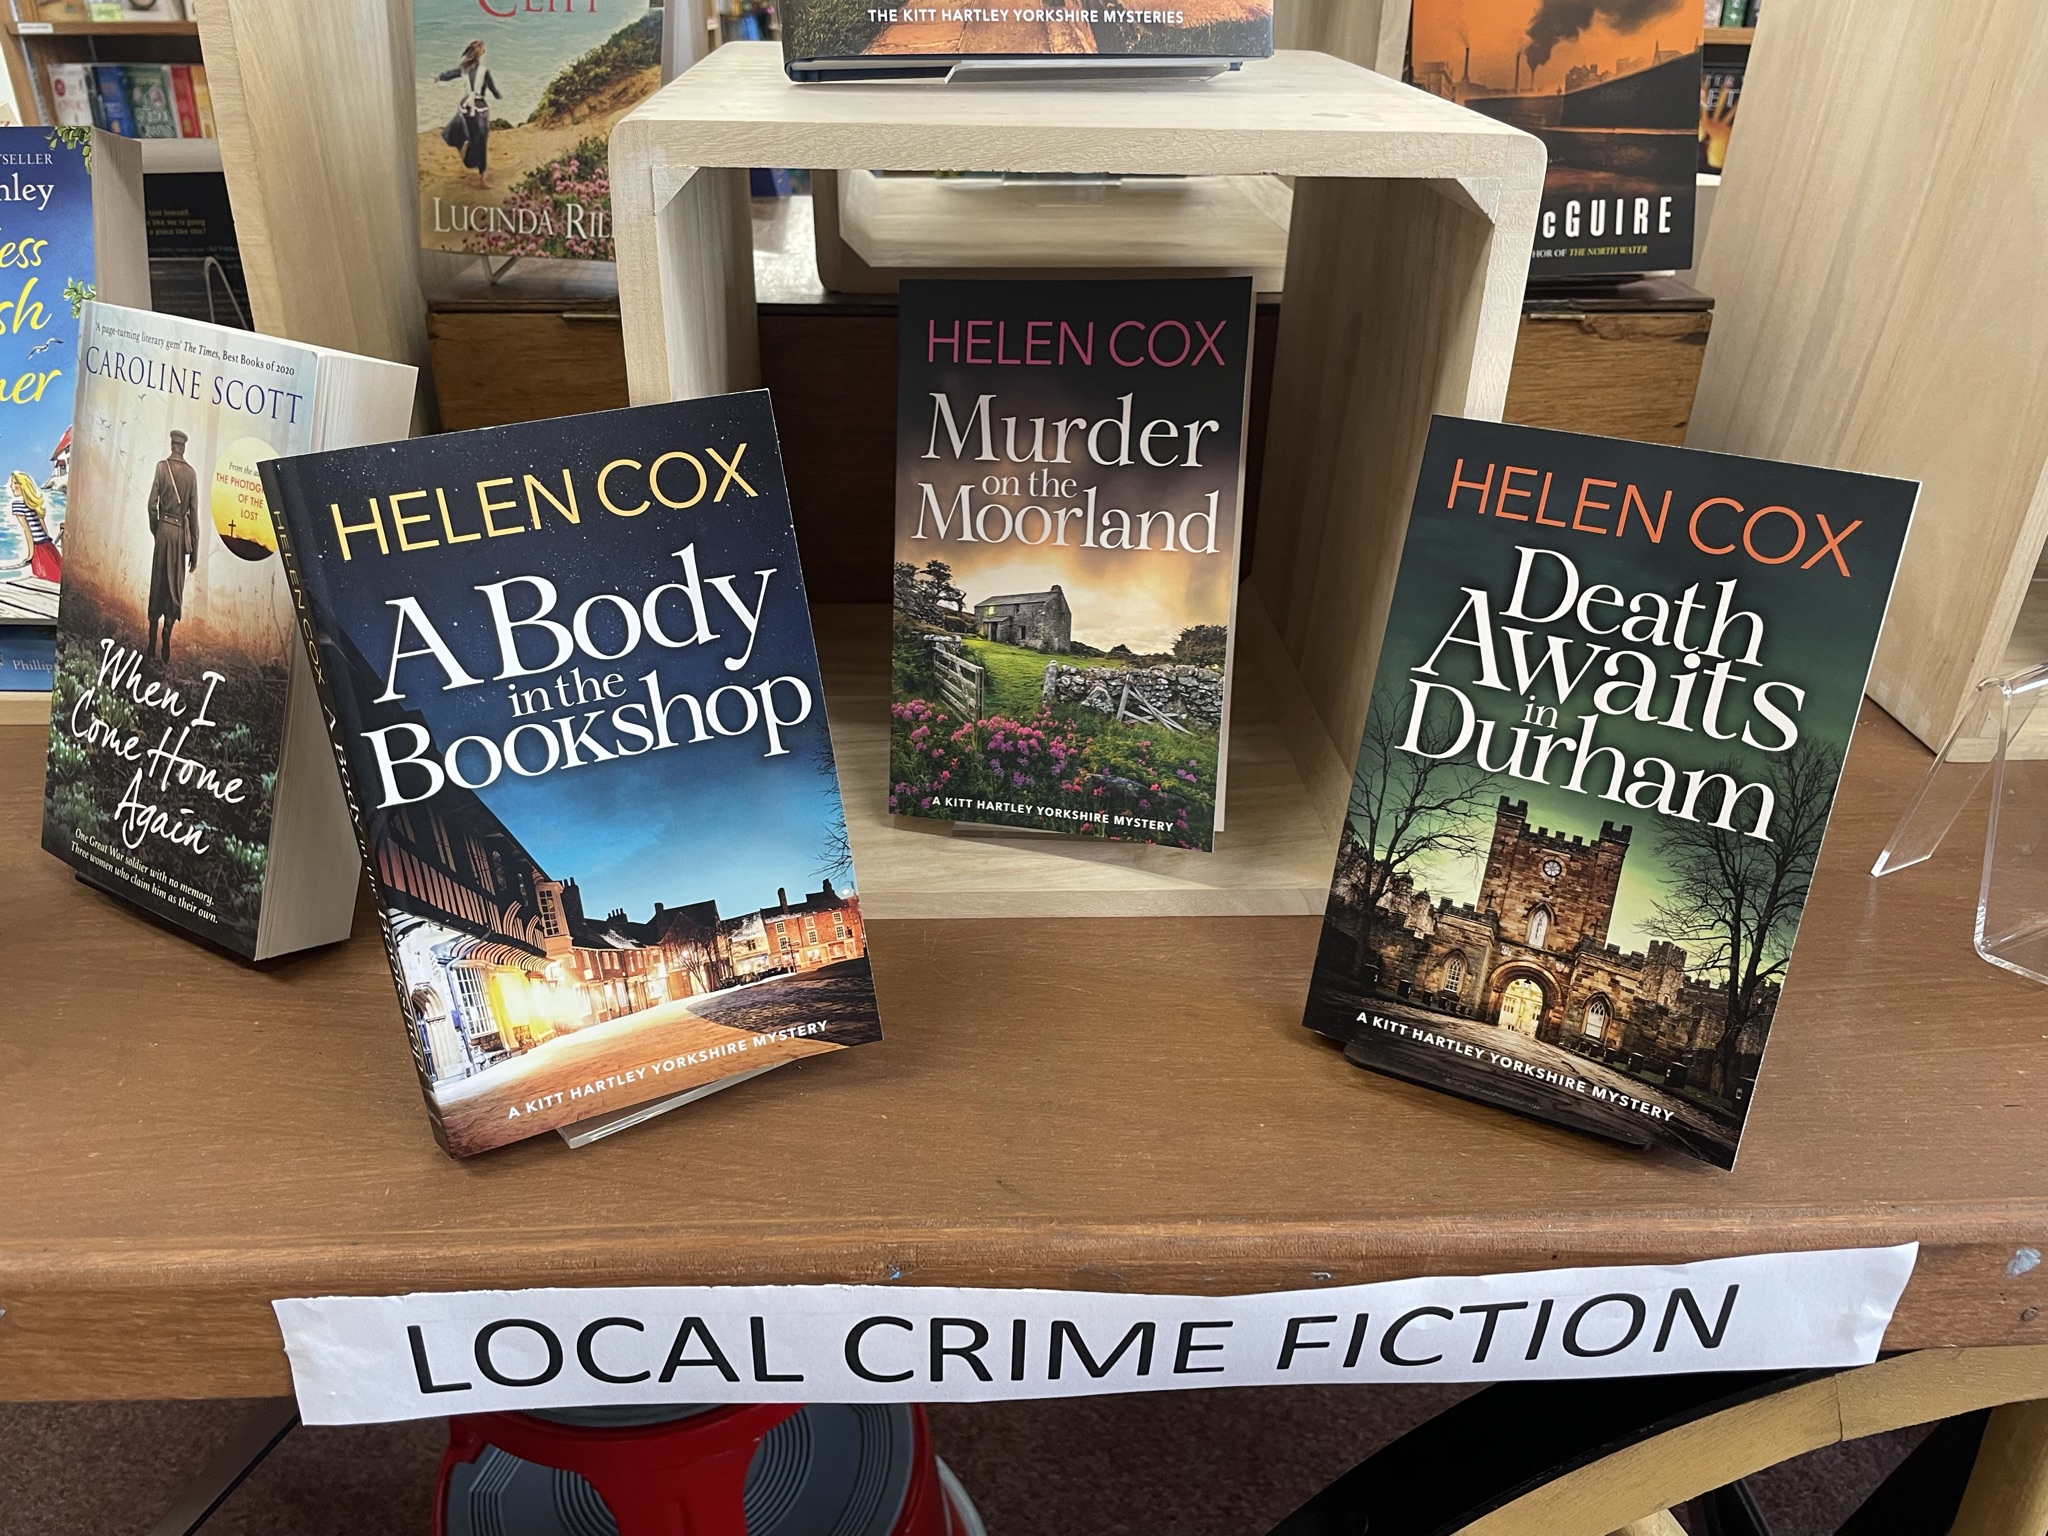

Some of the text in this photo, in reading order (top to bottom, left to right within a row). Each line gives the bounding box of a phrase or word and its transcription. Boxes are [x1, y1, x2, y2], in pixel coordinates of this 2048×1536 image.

[866, 8, 1184, 25] THE KITT HARTLEY YORKSHIRE MYSTERIES
[0, 153, 54, 165] SELLER
[432, 197, 613, 240] LUCINDA RIL
[1554, 249, 1567, 257] OF
[1569, 248, 1586, 256] THE
[1587, 246, 1618, 256] NORTH
[1620, 245, 1648, 255] WATER
[101, 326, 141, 344] page-turning
[141, 332, 166, 348] literary
[183, 341, 197, 354] The
[198, 345, 222, 361] Times,
[222, 350, 239, 364] Best
[240, 355, 265, 369] Books
[265, 361, 276, 372] of
[276, 364, 295, 376] 2020
[928, 319, 1227, 367] HELEN COX
[86, 346, 303, 424] CAROLINE SCOTT
[920, 392, 1220, 467] Murder
[216, 472, 229, 484] THE
[229, 461, 243, 473] From
[244, 465, 253, 476] the
[238, 493, 264, 509] OF THE
[330, 442, 759, 561] HELEN COX
[982, 467, 1078, 499] on the
[240, 508, 258, 522] LOST
[911, 482, 1220, 555] Moorland
[1447, 458, 1863, 578] HELEN COX
[274, 510, 327, 686] HELEN COX
[373, 543, 777, 704] A Body
[1499, 545, 1765, 667] Death
[98, 638, 226, 728] When I
[508, 667, 627, 719] in the
[1411, 586, 1806, 753] Awaits
[71, 686, 246, 804] Come Home
[323, 702, 336, 732] A
[1521, 694, 1559, 730] in
[1394, 678, 1776, 843] Durham
[114, 767, 210, 854] Again
[932, 796, 1174, 832] A KITT HARTLEY YORKSHIRE MYSTERY
[71, 840, 218, 924] Three women who claim him as their own.
[75, 827, 215, 907] One Great War soldier with no memory.
[507, 1020, 829, 1120] A KITT HARTLEY YORKSHIRE MYSTERY
[1355, 1011, 1675, 1122] A KITT HARTLEY YORKSHIRE MYSTERY
[407, 1283, 1740, 1394] LOCAL CRIME FICTION
